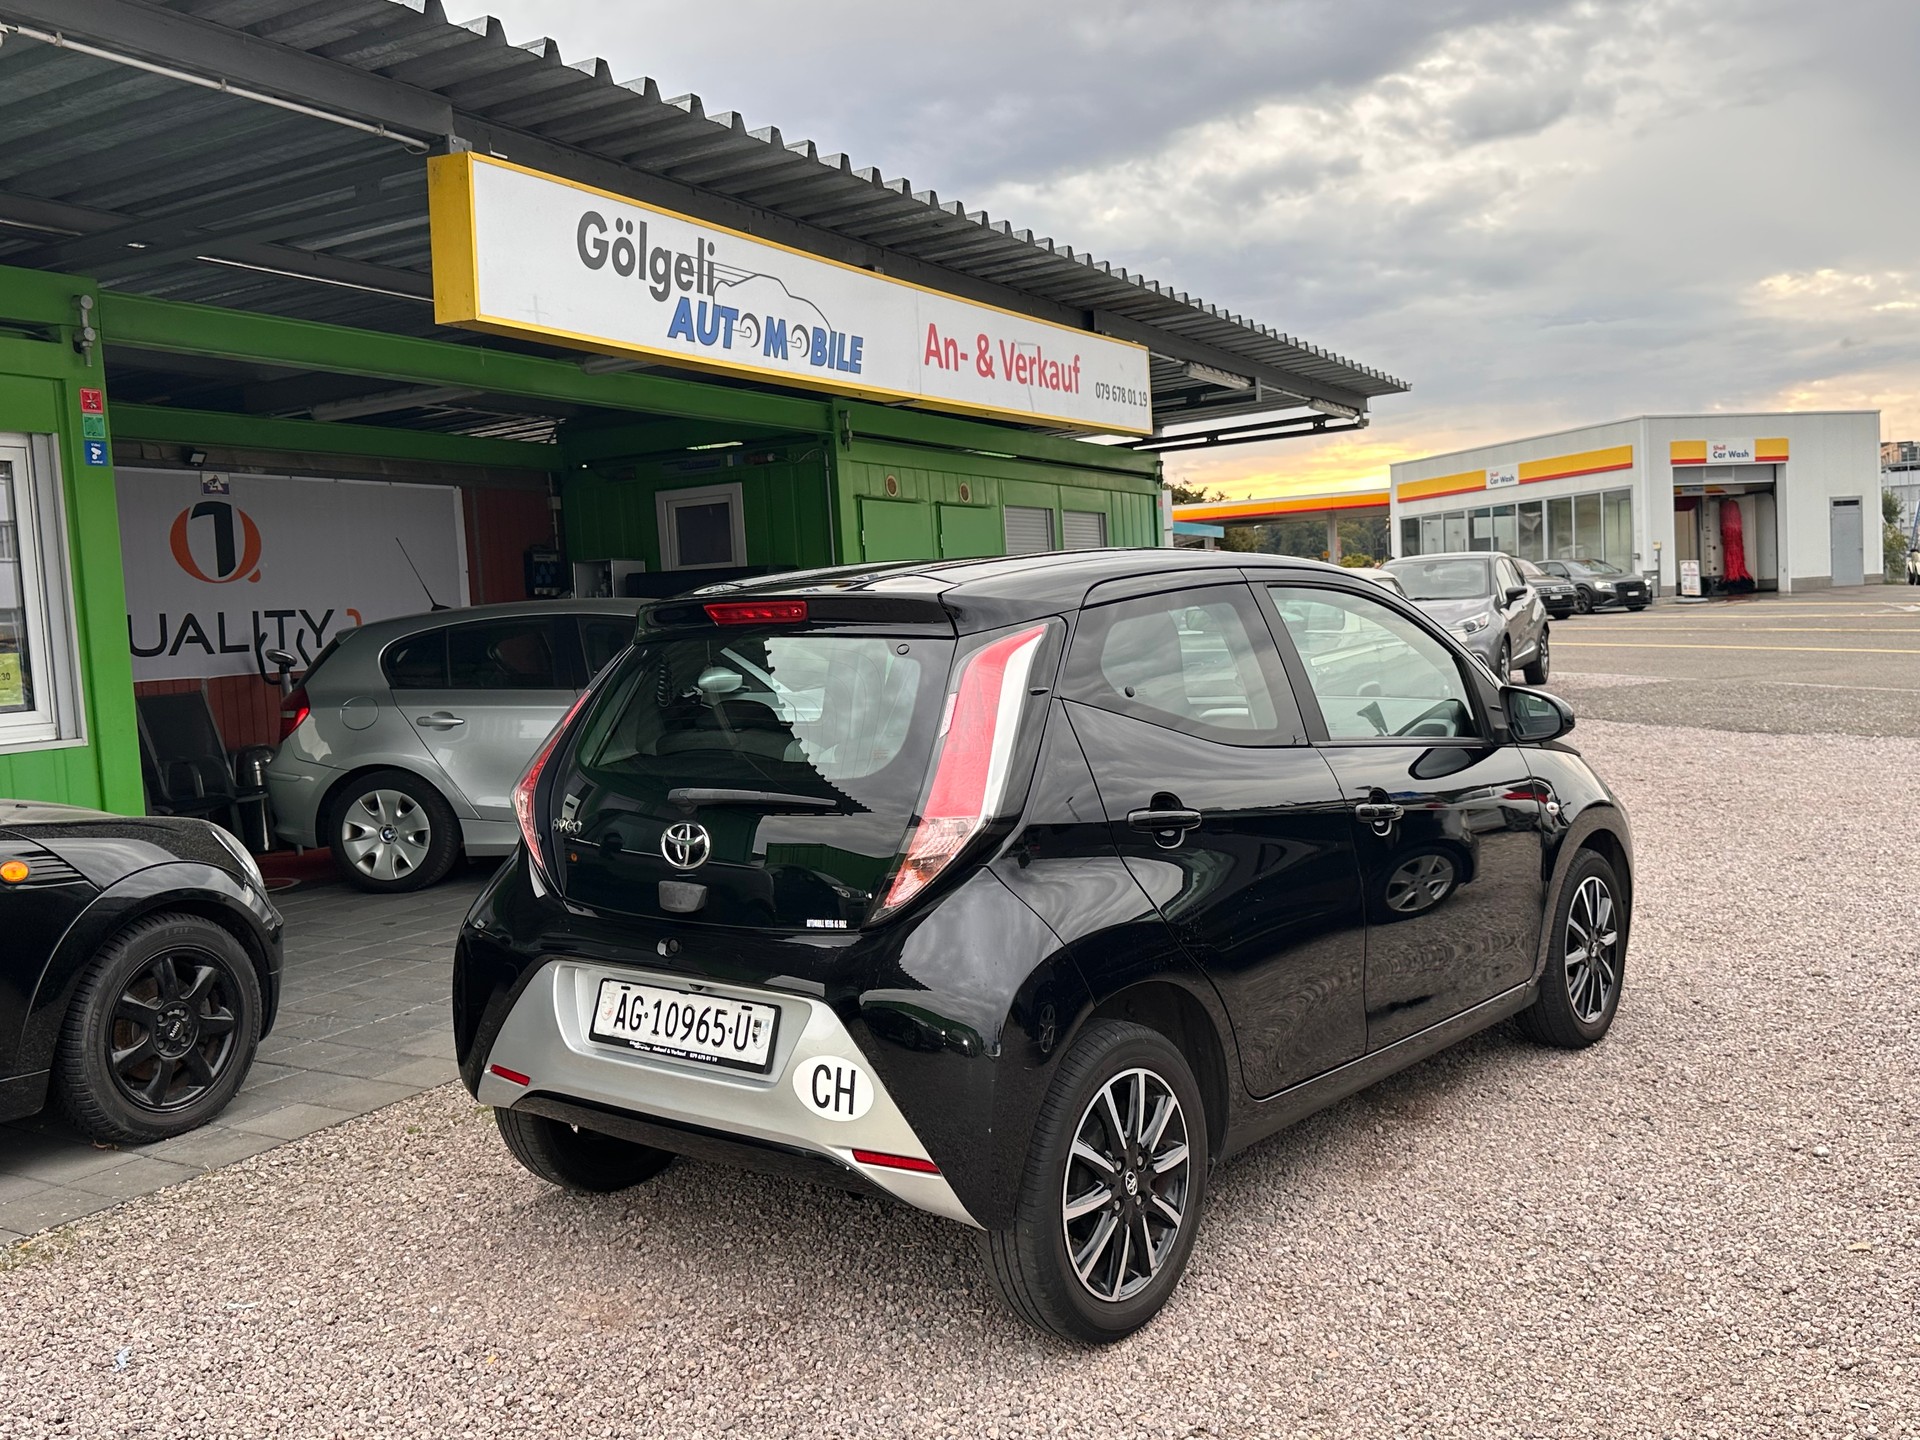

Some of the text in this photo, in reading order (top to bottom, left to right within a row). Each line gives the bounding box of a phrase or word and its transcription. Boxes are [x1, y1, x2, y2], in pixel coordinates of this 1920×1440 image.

[577, 210, 715, 302] Gölgeli
[667, 296, 864, 374] AUTOMOBILE
[924, 323, 1081, 394] An- & Verkauf
[1095, 381, 1148, 407] 079 678 01 19
[1713, 449, 1749, 459] Car Wash
[127, 608, 335, 657] UALITY
[552, 817, 582, 834] AYGO
[811, 1064, 857, 1115] CH
